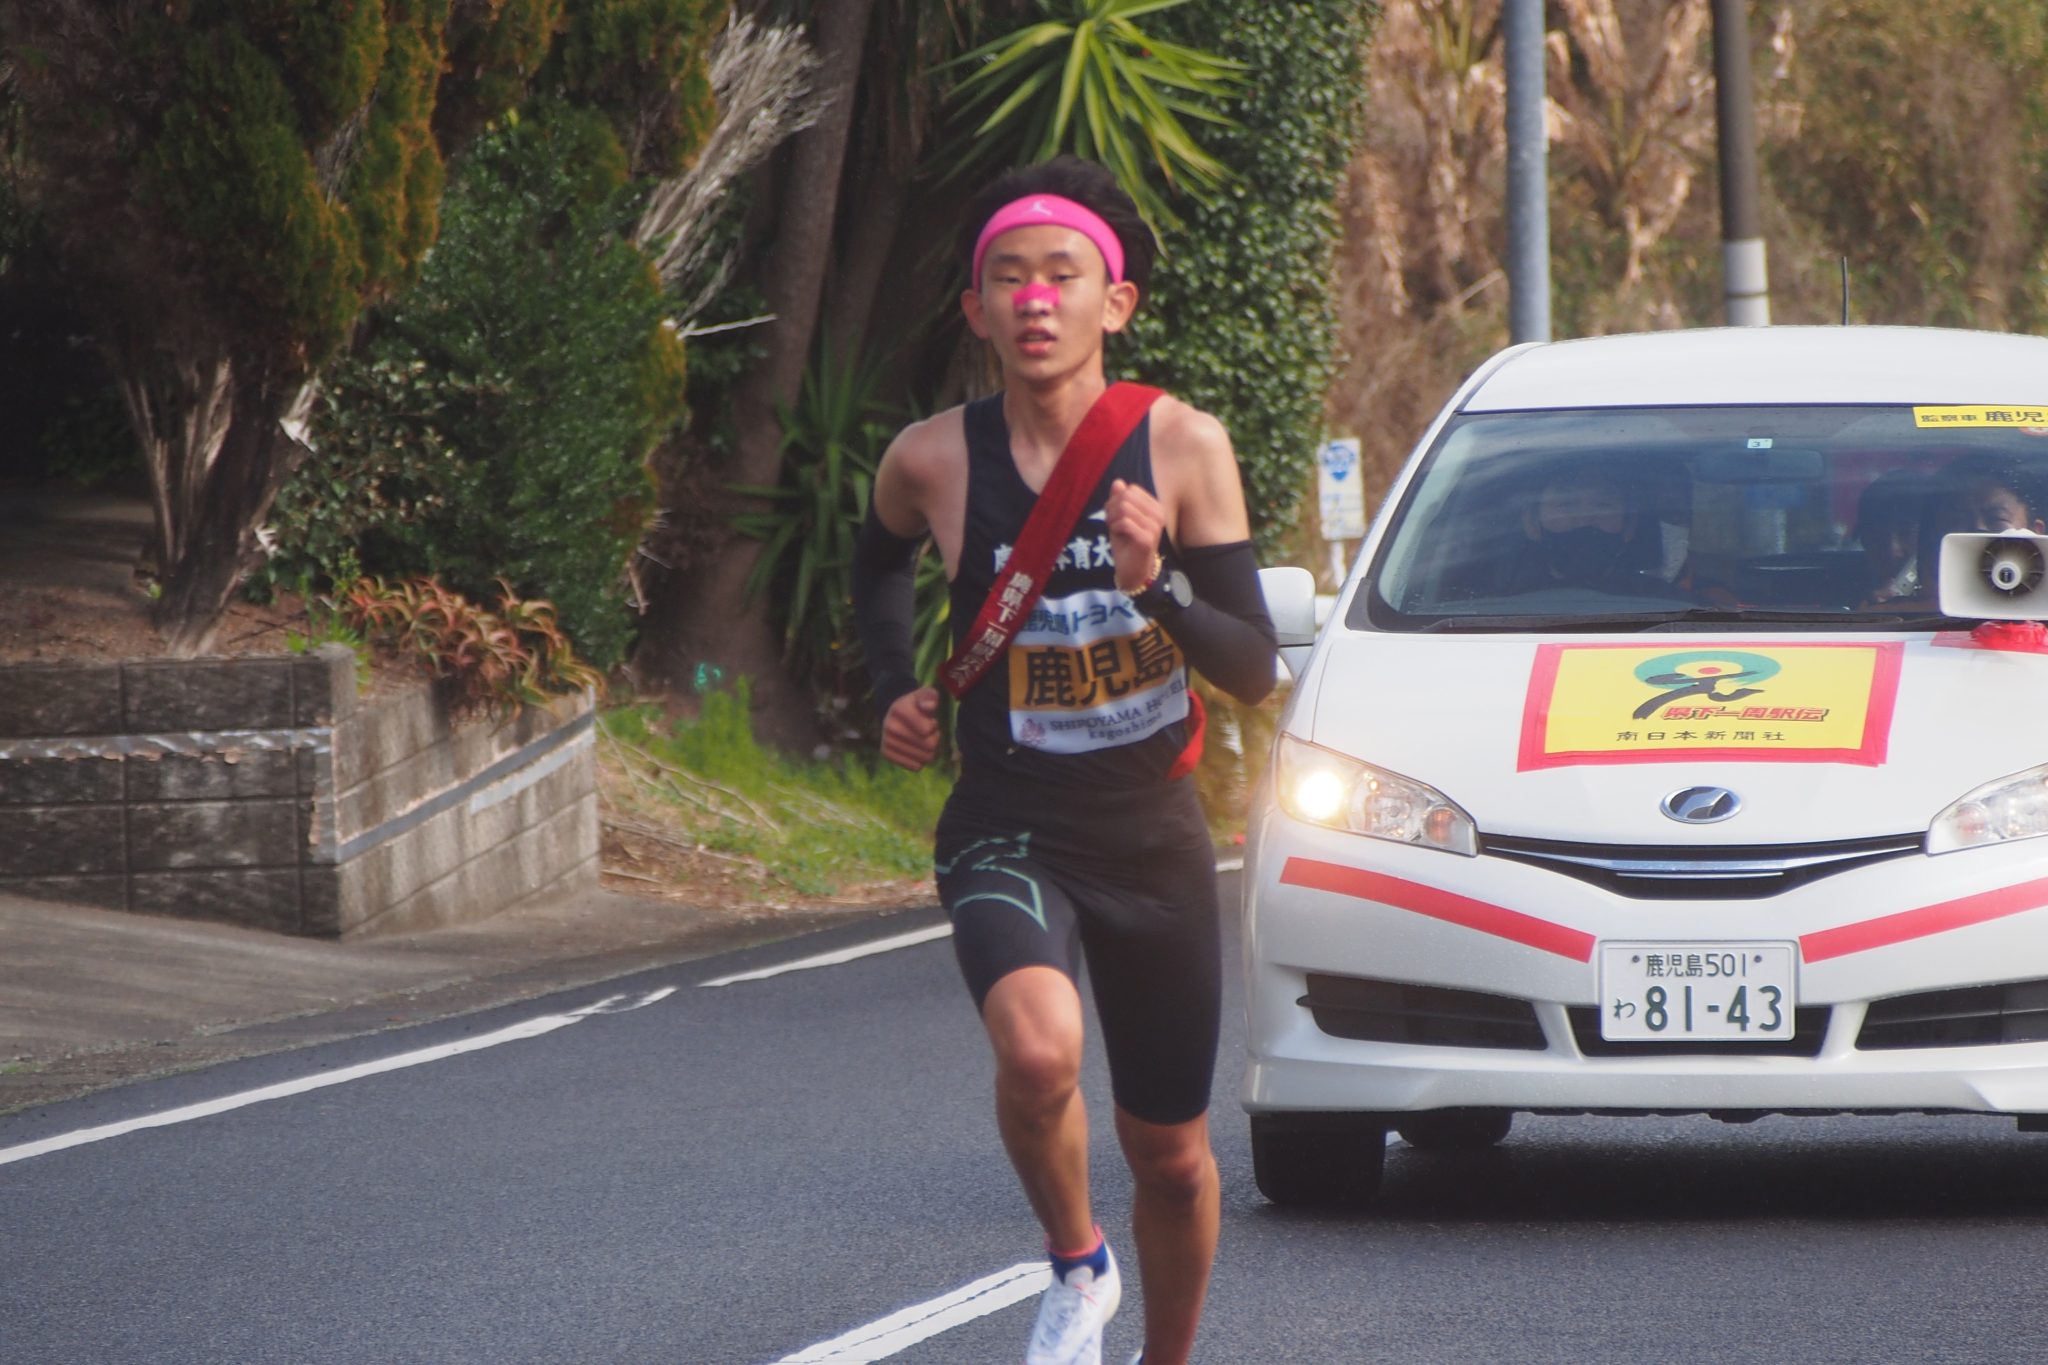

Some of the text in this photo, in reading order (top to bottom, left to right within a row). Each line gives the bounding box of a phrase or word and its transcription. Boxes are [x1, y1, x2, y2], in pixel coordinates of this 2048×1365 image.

[1985, 410, 2048, 423] 鹿児
[1025, 624, 1177, 707] 鹿児島
[1049, 707, 1142, 732] SHIROYAMA
[1662, 705, 1830, 722] 県下一周駅伝
[1616, 730, 1786, 742] 南日本新聞社
[1613, 984, 1783, 1032] わ 81-43
